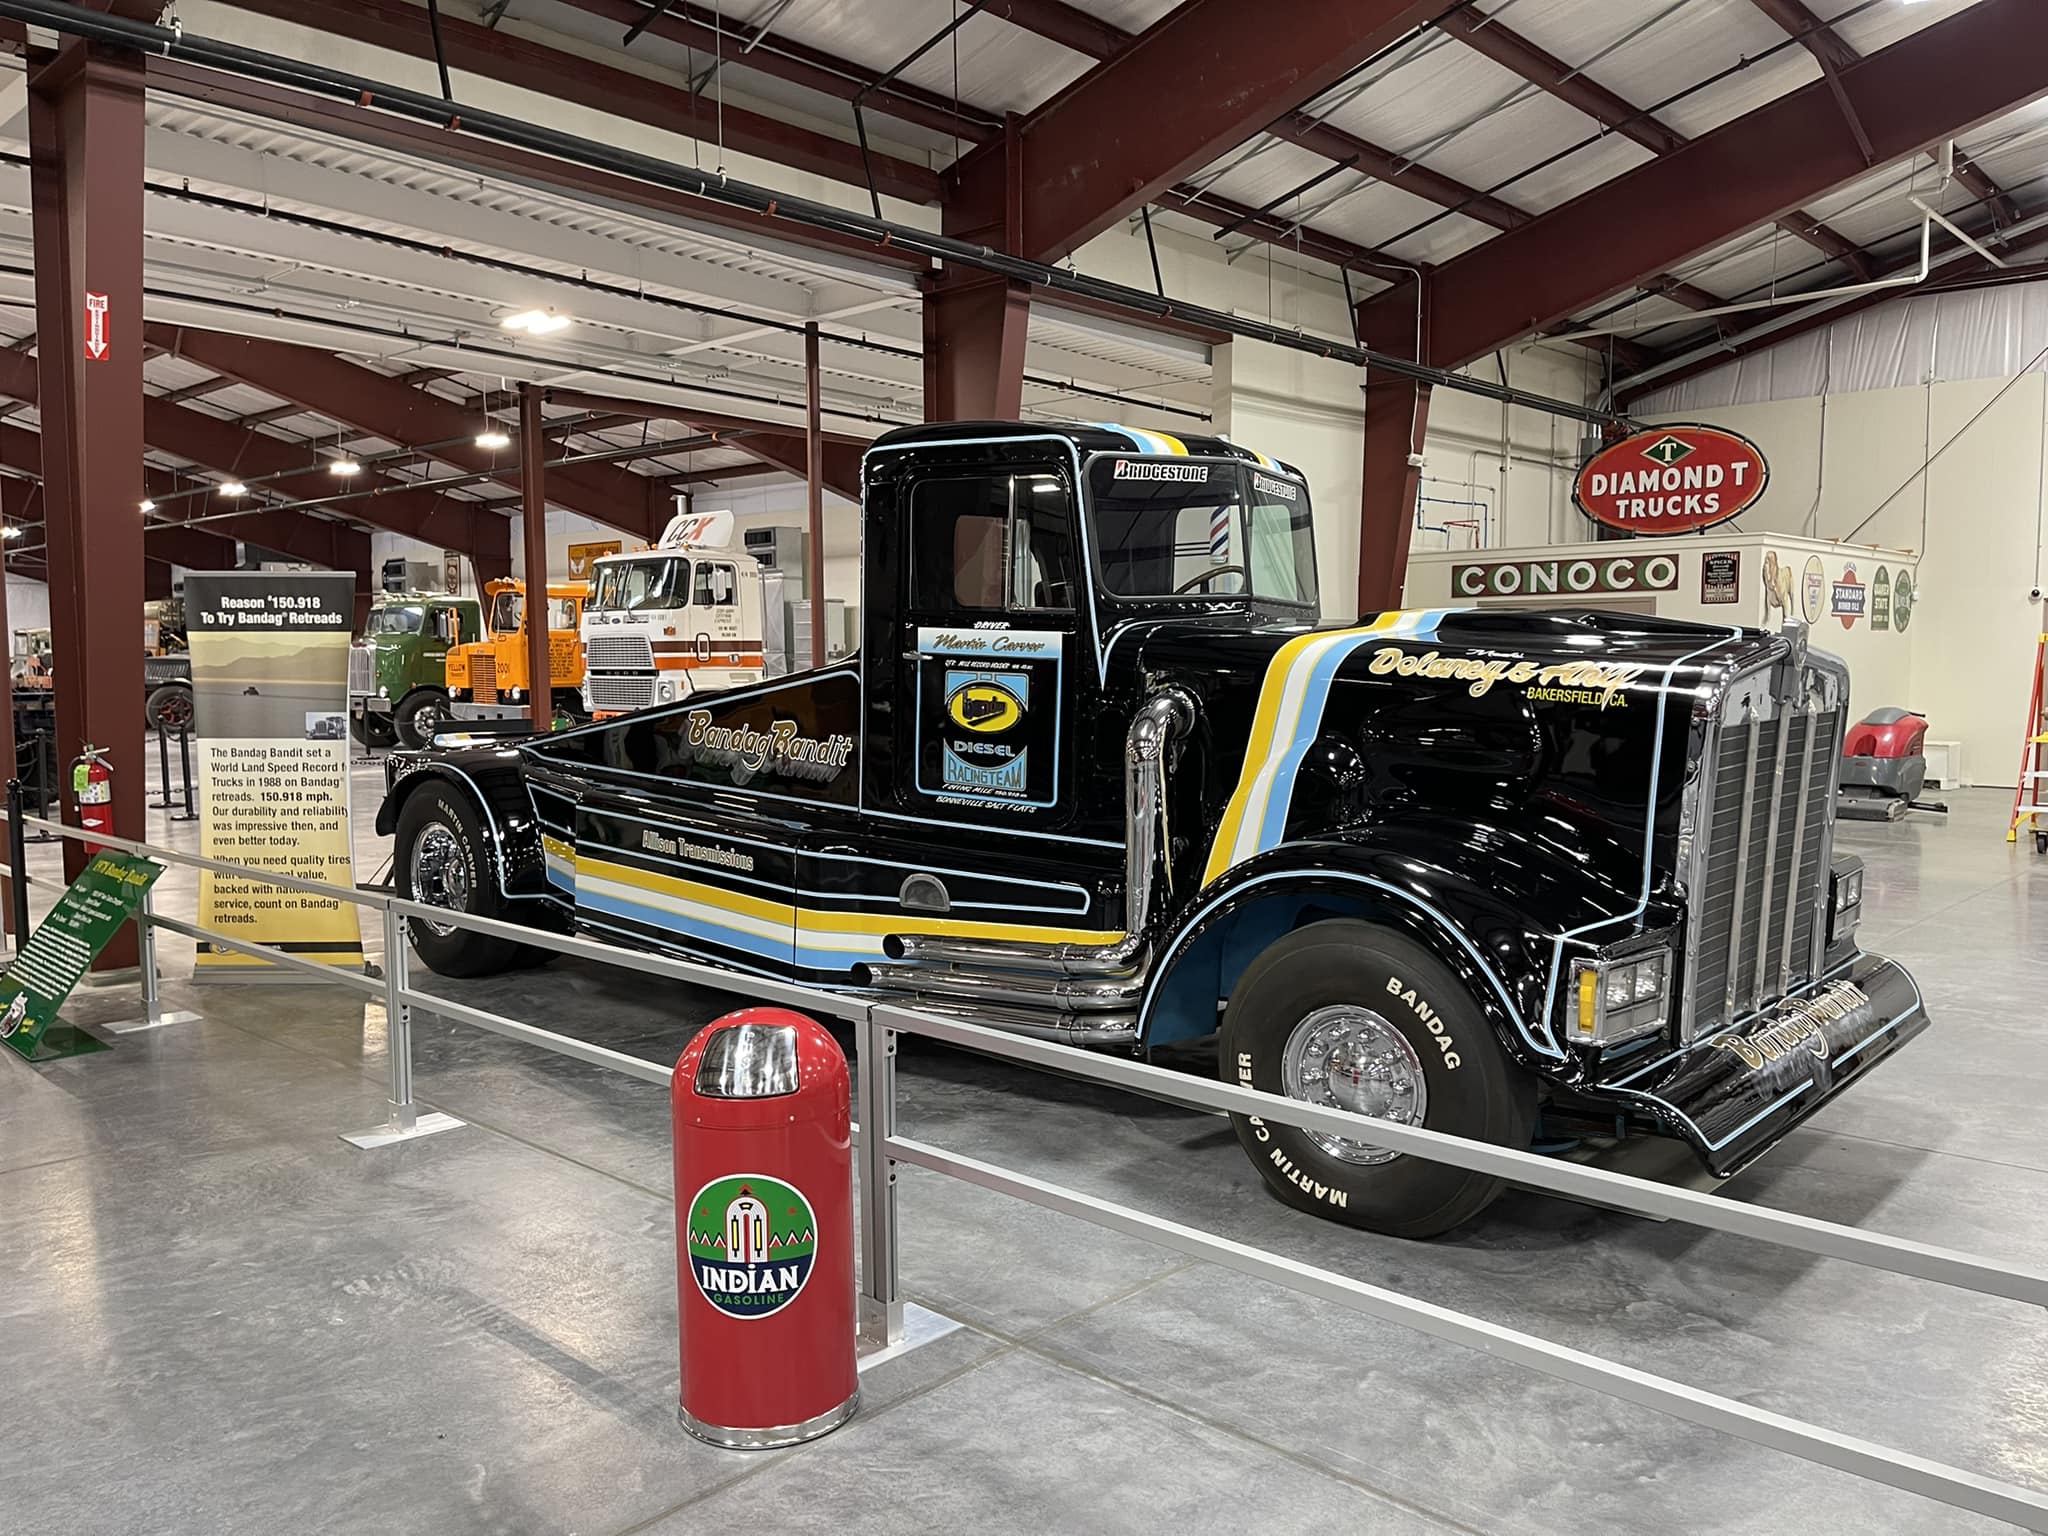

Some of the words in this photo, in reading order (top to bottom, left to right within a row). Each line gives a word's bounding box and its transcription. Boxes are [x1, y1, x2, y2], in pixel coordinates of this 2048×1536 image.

[89, 298, 105, 309] FIRE
[1659, 442, 1677, 462] T
[1116, 461, 1206, 481] BRIDGESTONE
[1592, 464, 1724, 496] DIAMOND
[1731, 461, 1749, 486] T
[1254, 473, 1296, 500] BRIDGESTONE
[1616, 493, 1720, 519] TRUCKS
[667, 517, 716, 542] CCX
[1460, 557, 1676, 595] CONOCO
[1835, 588, 1862, 601] STANDARD
[221, 596, 265, 609] Reason
[201, 612, 215, 624] To
[217, 612, 235, 626] Try
[289, 612, 342, 624] Retreads
[974, 621, 1011, 629] DRIVER
[933, 634, 988, 650] Martin
[992, 636, 1046, 652] Carver
[1369, 648, 1511, 698] Delaney
[1609, 694, 1629, 707] CA.
[689, 710, 773, 771] Bandag
[771, 720, 852, 766] Bandit
[211, 748, 228, 758] The
[231, 748, 267, 759] Bandag
[270, 748, 303, 757] Bandit
[306, 748, 322, 758] set
[325, 750, 331, 758] a
[954, 740, 1016, 757] DIESEL
[211, 762, 239, 772] World
[242, 762, 265, 772] Land
[268, 762, 299, 774] Speed
[302, 762, 338, 772] Record
[947, 754, 988, 784] RACING
[988, 762, 1022, 788] TEAM
[212, 777, 243, 787] Trucks
[246, 777, 256, 786] in
[259, 777, 282, 787] 1988
[285, 779, 298, 787] on
[212, 792, 254, 802] retreads.
[260, 792, 303, 801] 150.918
[306, 792, 333, 803] mph.
[936, 796, 985, 807] BONNEVILLE
[985, 801, 1008, 810] SALT
[1007, 803, 1037, 813] FLATS
[212, 807, 228, 816] Our
[232, 806, 277, 818] durability
[280, 807, 299, 816] and
[303, 806, 348, 817] reliability
[213, 822, 232, 831] was
[235, 821, 288, 832] impressive
[291, 821, 317, 832] then,
[319, 821, 339, 831] and
[213, 837, 235, 845] even
[238, 836, 266, 845] better
[269, 836, 300, 847] today.
[438, 799, 464, 834] MARTIN
[462, 836, 477, 888] CARVER
[642, 829, 677, 855] Allison
[678, 837, 754, 871] Transmissions
[213, 855, 241, 865] When
[243, 856, 260, 866] you
[263, 855, 287, 865] need
[290, 855, 325, 866] quality
[328, 855, 351, 865] tires
[296, 869, 327, 880] value,
[214, 884, 249, 894] backed
[252, 884, 274, 894] with
[214, 899, 252, 910] service,
[254, 899, 282, 909] count
[285, 901, 298, 909] on
[301, 899, 339, 910] Bandag
[214, 914, 258, 924] retreads.
[1385, 976, 1462, 1070] BANDAG
[1238, 1052, 1271, 1142] CAER
[1269, 1148, 1349, 1208] MARTIN
[713, 1292, 785, 1305] GASOLINE
